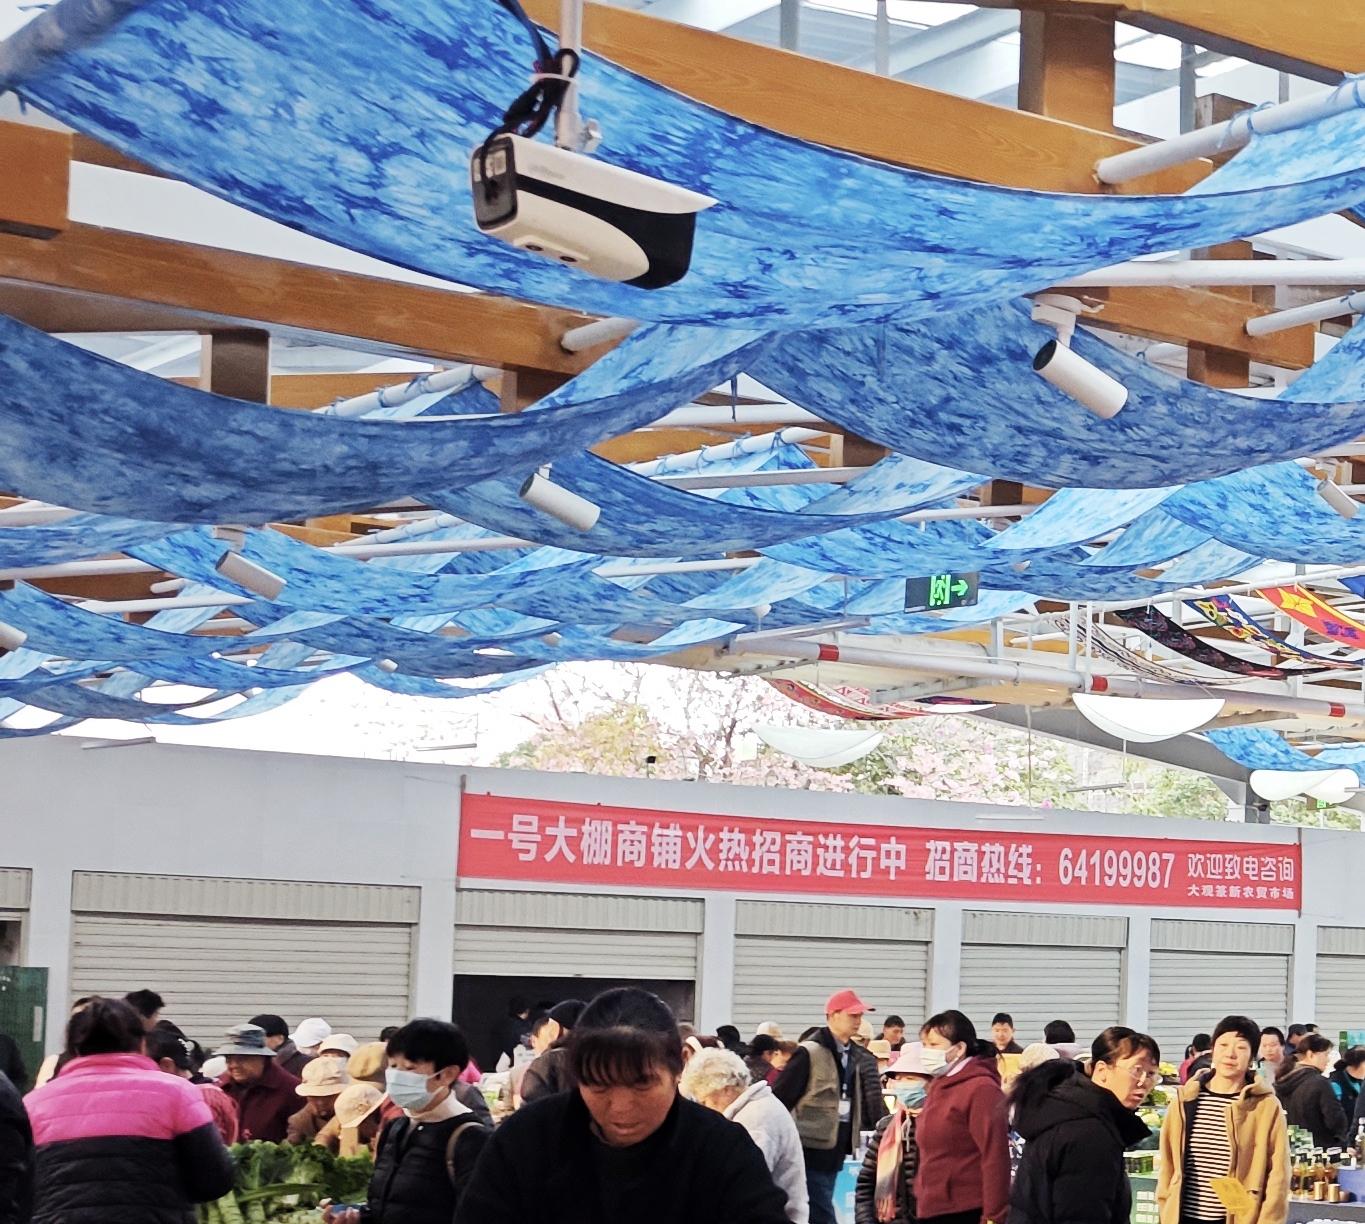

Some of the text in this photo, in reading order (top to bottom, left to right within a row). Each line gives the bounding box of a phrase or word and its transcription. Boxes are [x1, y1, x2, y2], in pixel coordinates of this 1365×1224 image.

[470, 813, 907, 880] 一号大棚商铺火热招商进行中
[1187, 852, 1295, 882] 欢迎致电咨询
